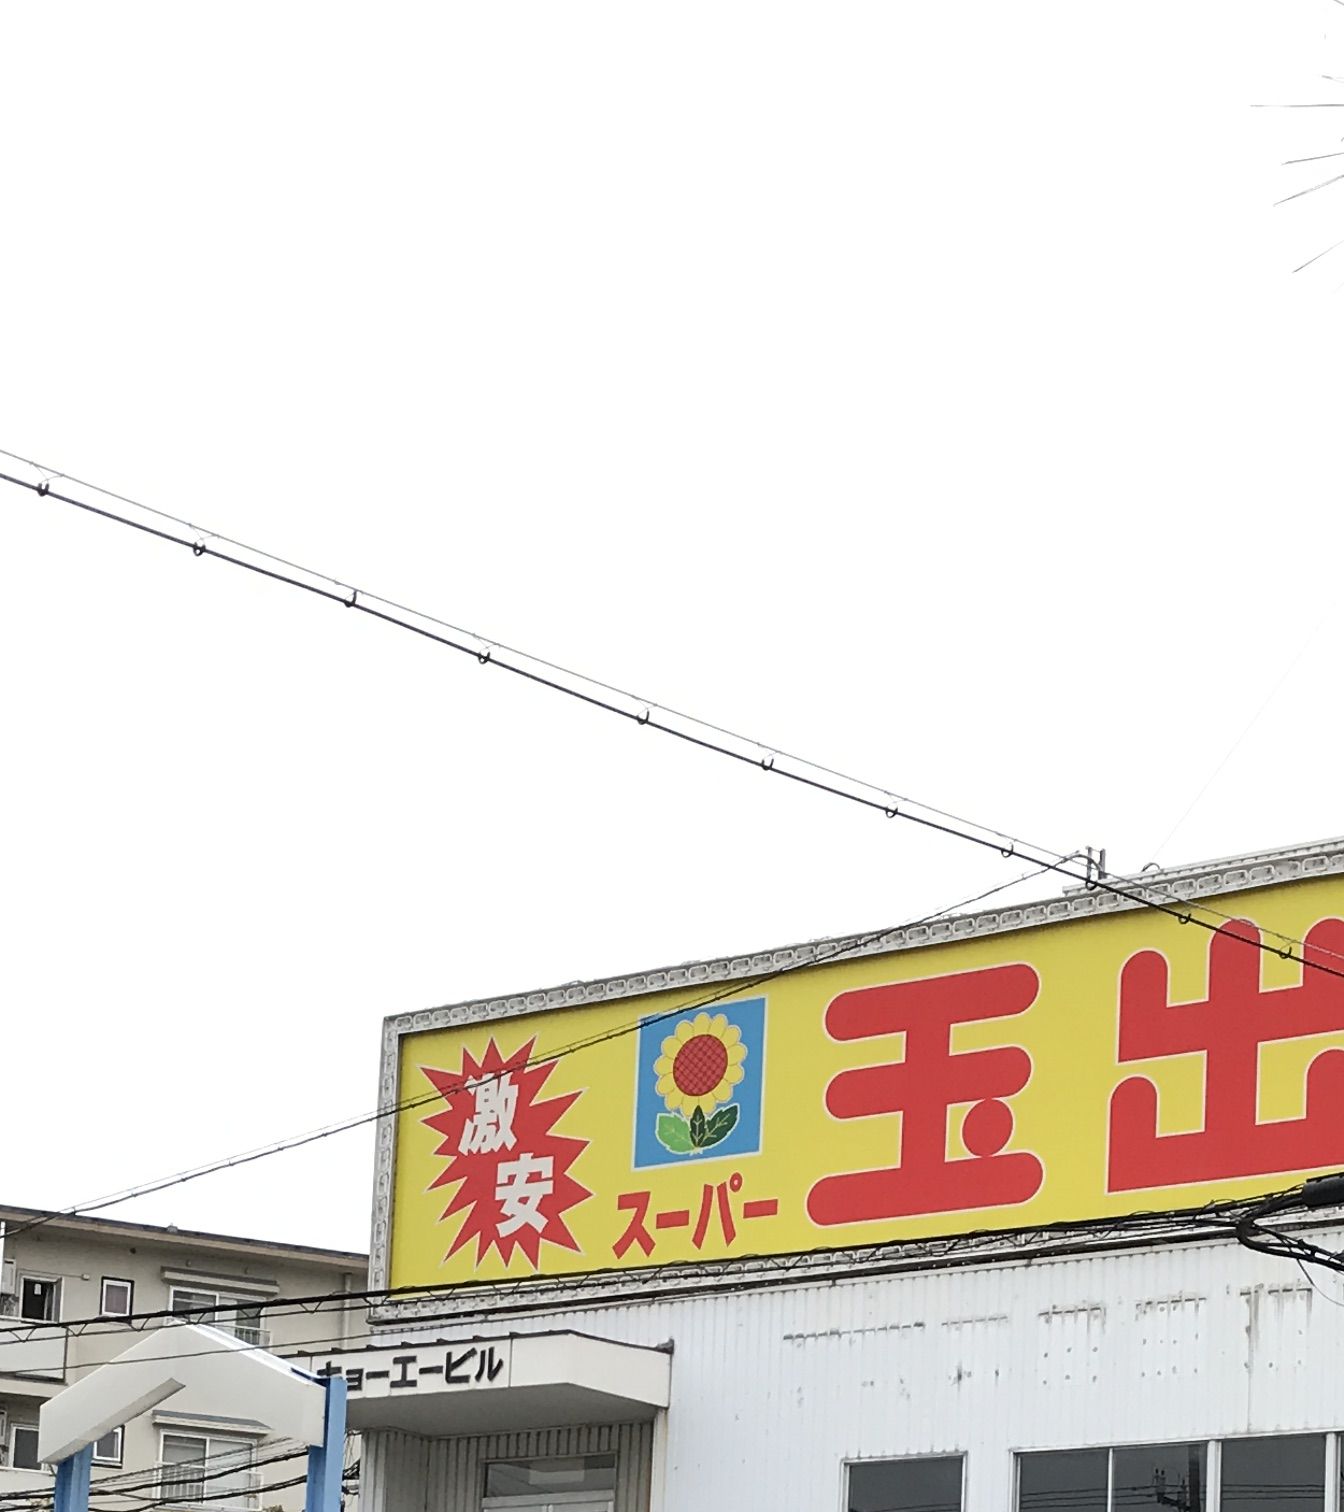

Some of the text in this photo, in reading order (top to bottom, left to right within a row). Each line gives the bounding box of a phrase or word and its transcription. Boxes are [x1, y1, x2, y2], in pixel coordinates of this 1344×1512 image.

[459, 1071, 555, 1238] 激安
[612, 1172, 779, 1259] スーパー
